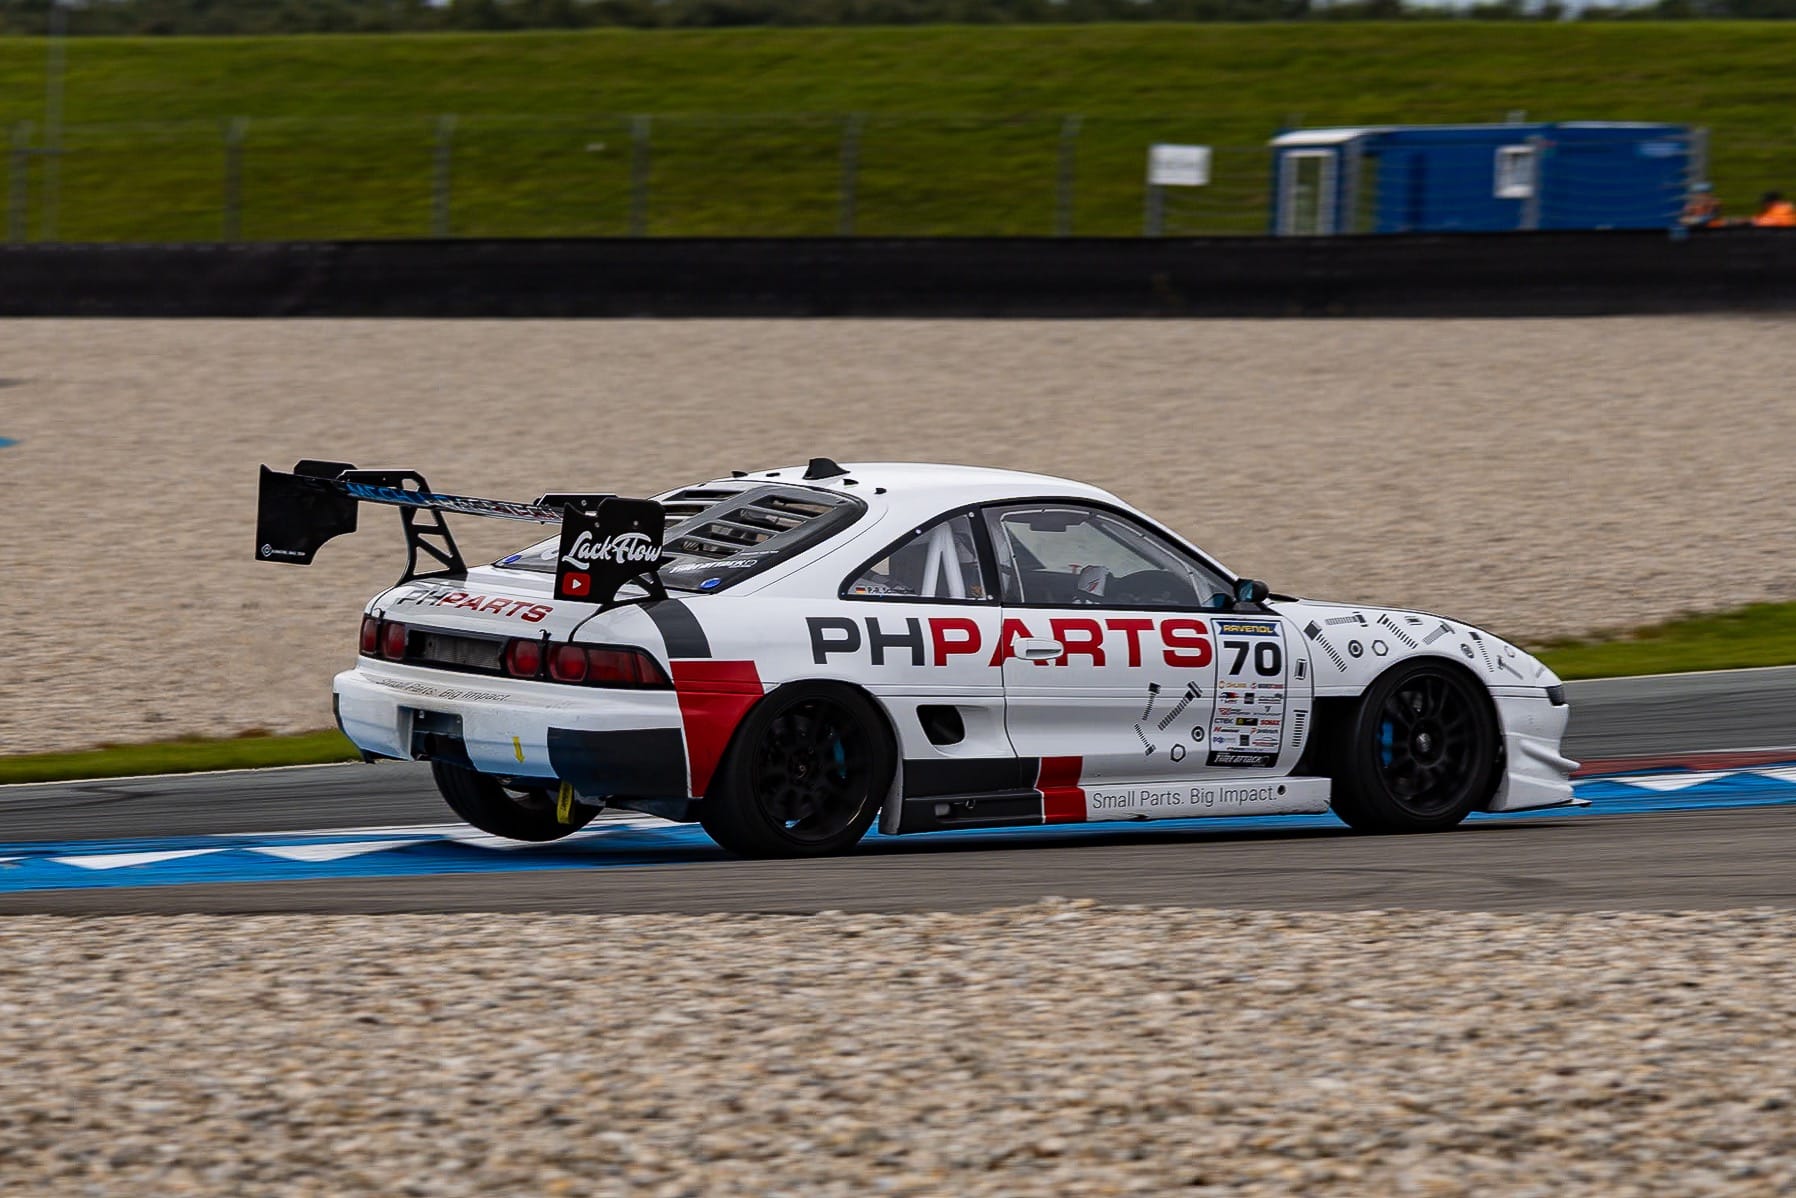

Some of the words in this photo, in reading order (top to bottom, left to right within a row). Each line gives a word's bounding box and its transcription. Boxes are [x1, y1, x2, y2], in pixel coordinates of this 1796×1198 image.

[807, 617, 1213, 668] PHPARTS
[1223, 624, 1274, 634] RAVENOL
[1223, 640, 1282, 677] 70
[1093, 791, 1135, 809] Small
[1140, 790, 1185, 806] Parts.
[1190, 788, 1215, 807] Big
[1219, 786, 1277, 806] Impact.
